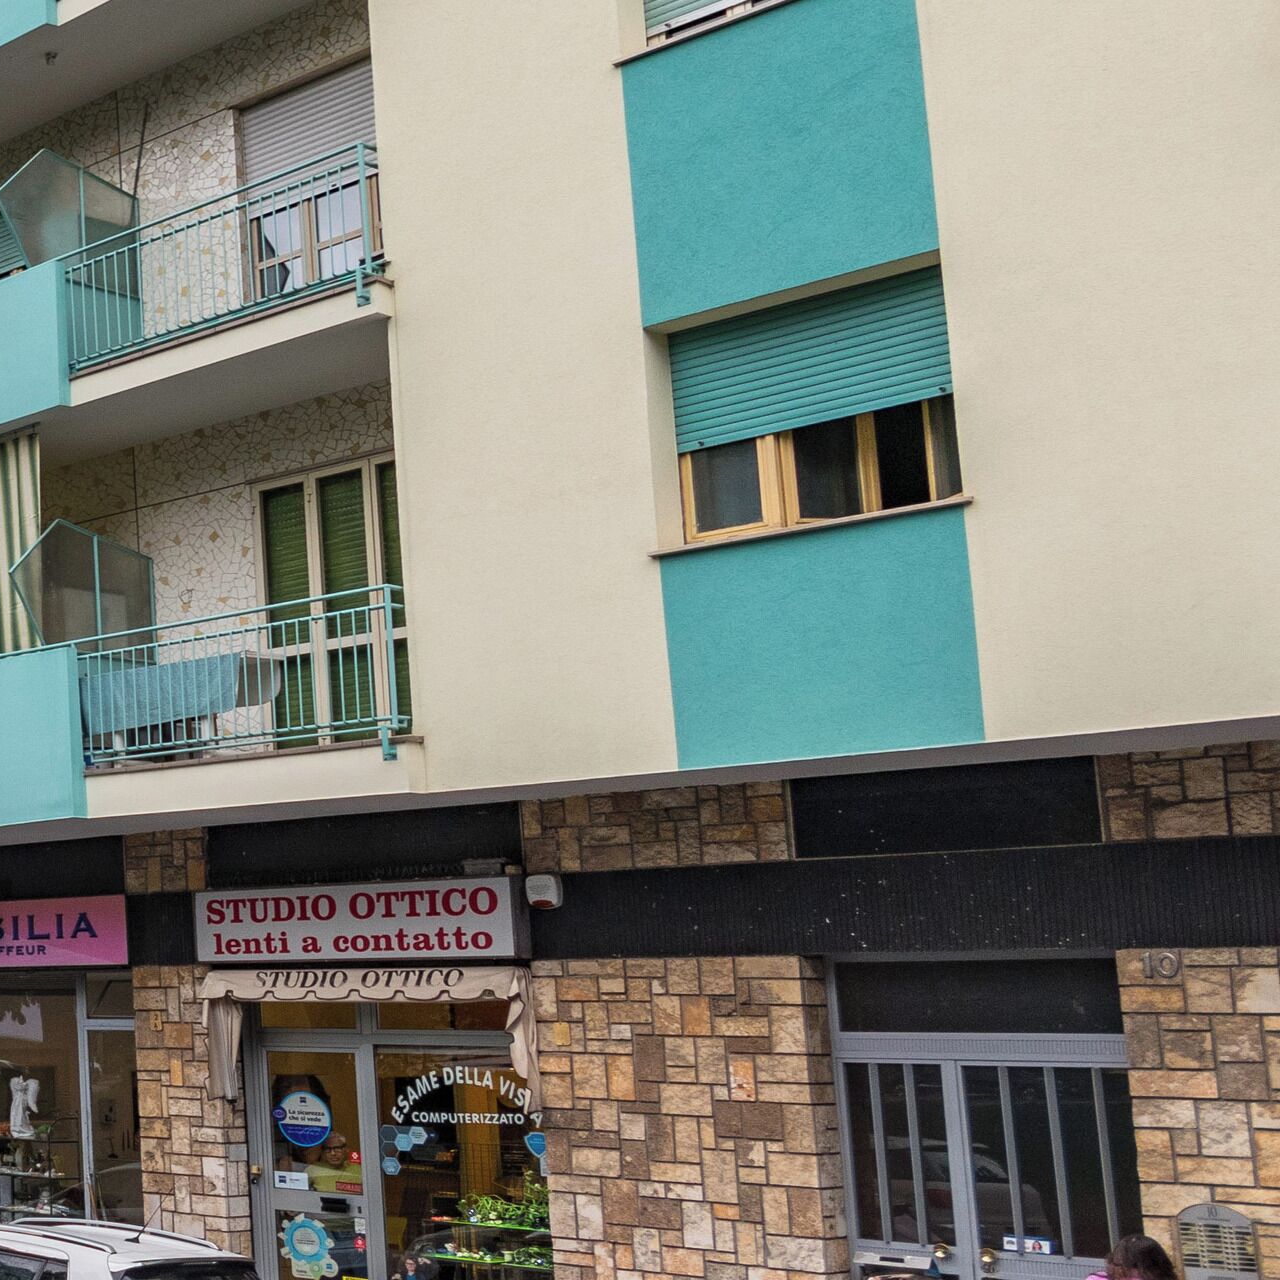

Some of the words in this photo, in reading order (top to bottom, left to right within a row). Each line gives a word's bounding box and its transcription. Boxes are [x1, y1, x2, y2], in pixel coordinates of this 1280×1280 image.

[206, 894, 337, 925] STUDIO
[349, 886, 498, 920] OTTICO
[213, 930, 290, 955] lenti
[302, 935, 321, 953] a
[333, 926, 493, 952] contatto
[256, 970, 348, 989] STUDIO
[361, 968, 464, 988] OTTICO
[1143, 952, 1178, 978] 10
[391, 1071, 440, 1124] ESAME
[442, 1065, 493, 1090] DELLA
[499, 1075, 543, 1128] VISA
[411, 1111, 524, 1125] COMPUTERIZZATO
